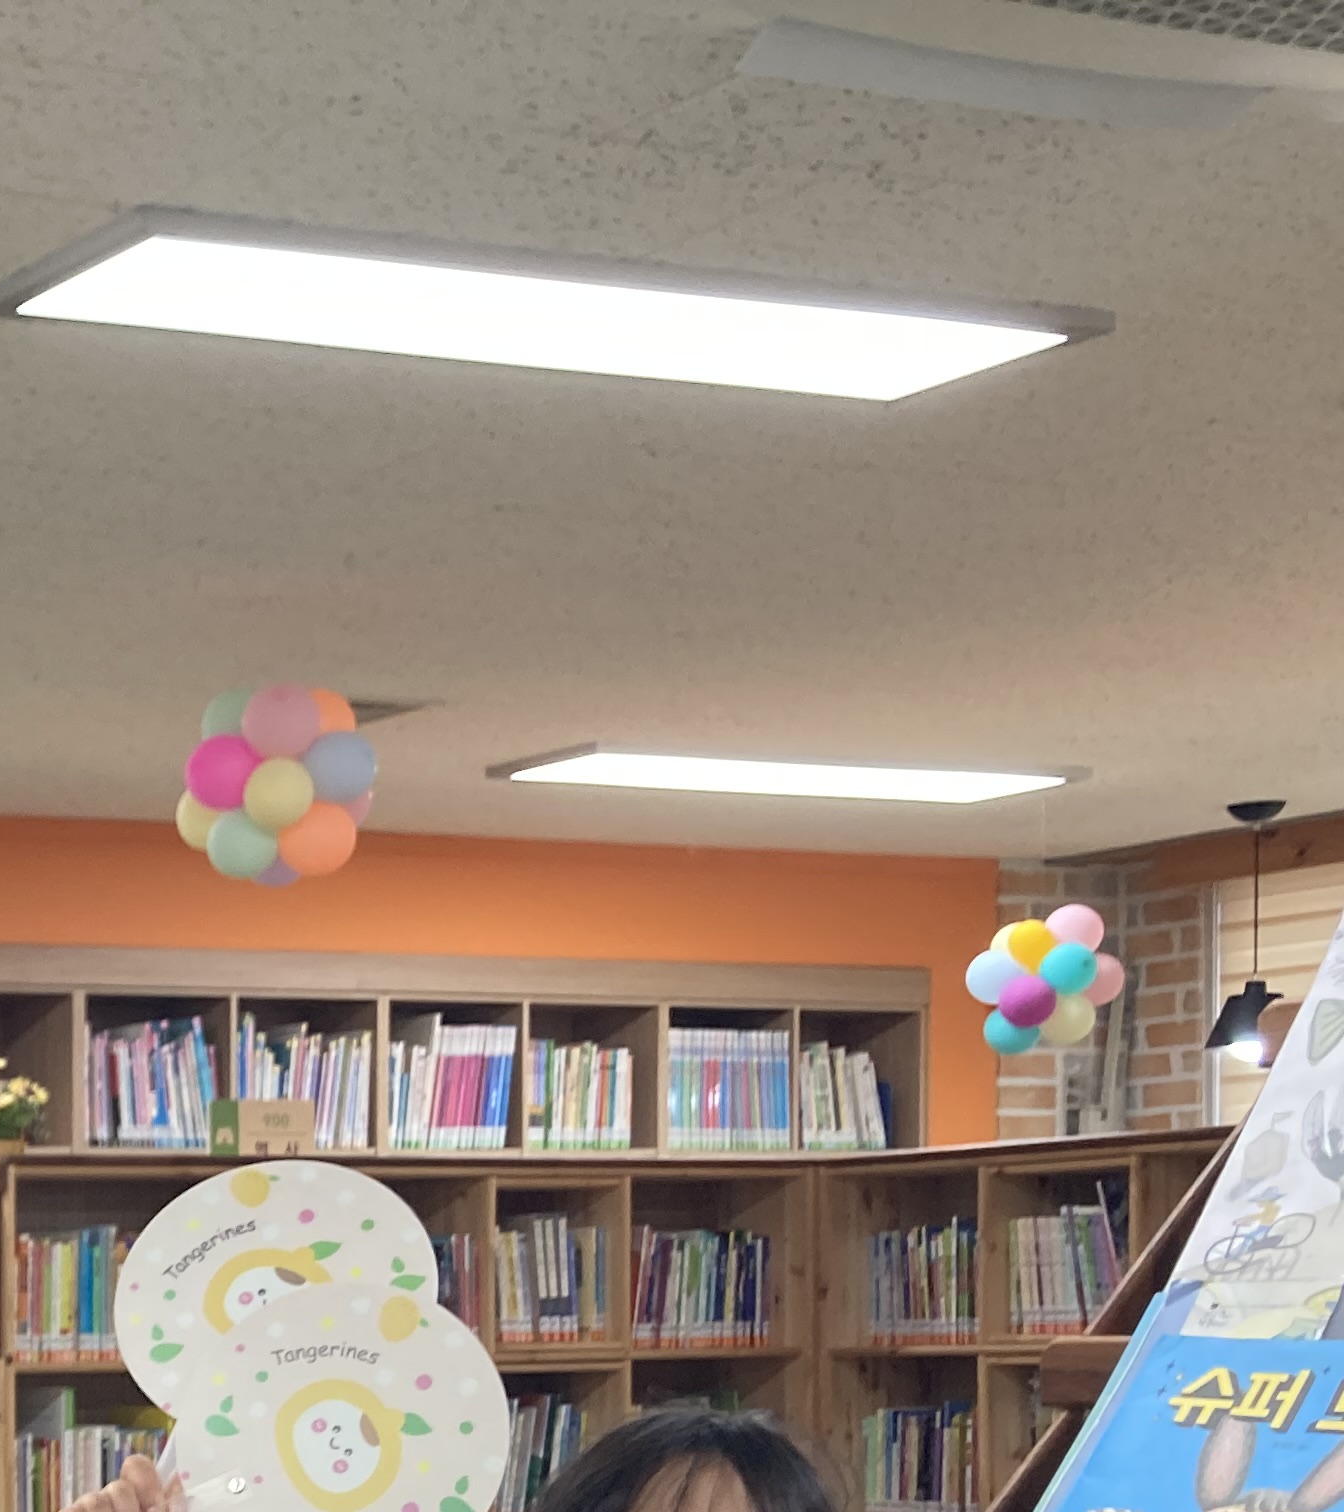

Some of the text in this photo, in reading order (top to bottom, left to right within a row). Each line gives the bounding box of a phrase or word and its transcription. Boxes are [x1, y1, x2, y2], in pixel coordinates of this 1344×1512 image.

[162, 1219, 257, 1280] Tangerines
[270, 1341, 382, 1367] Tangerines
[1169, 1367, 1314, 1431] 슈퍼
